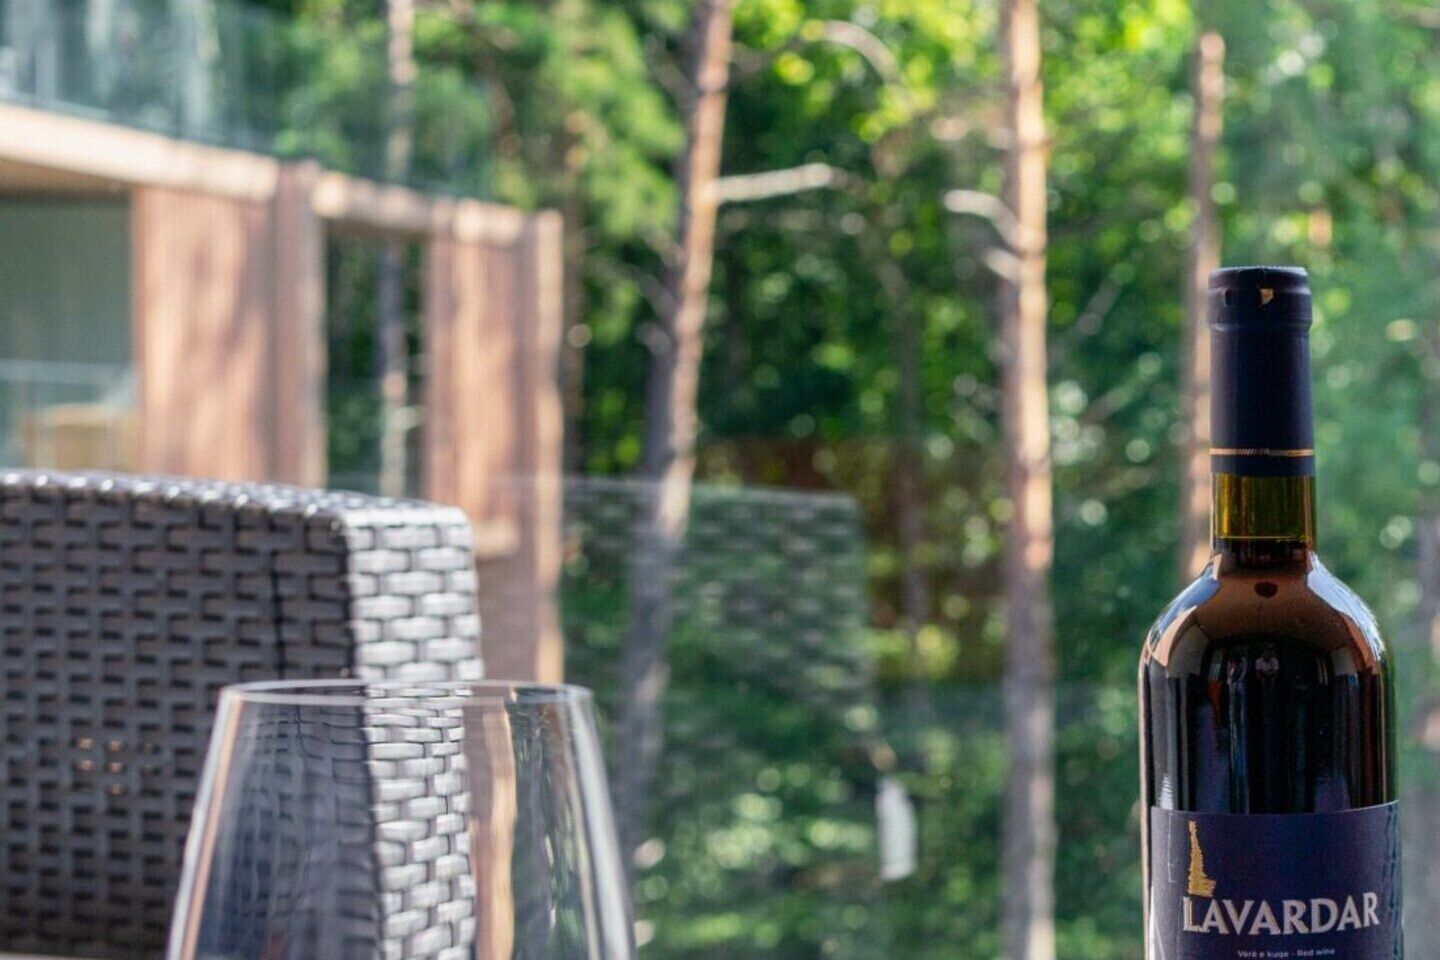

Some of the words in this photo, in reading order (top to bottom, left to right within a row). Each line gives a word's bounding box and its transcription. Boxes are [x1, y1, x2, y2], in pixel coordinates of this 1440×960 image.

[1182, 891, 1380, 936] LAVARDAR
[1297, 948, 1314, 957] Red
[1315, 947, 1335, 956] wine
